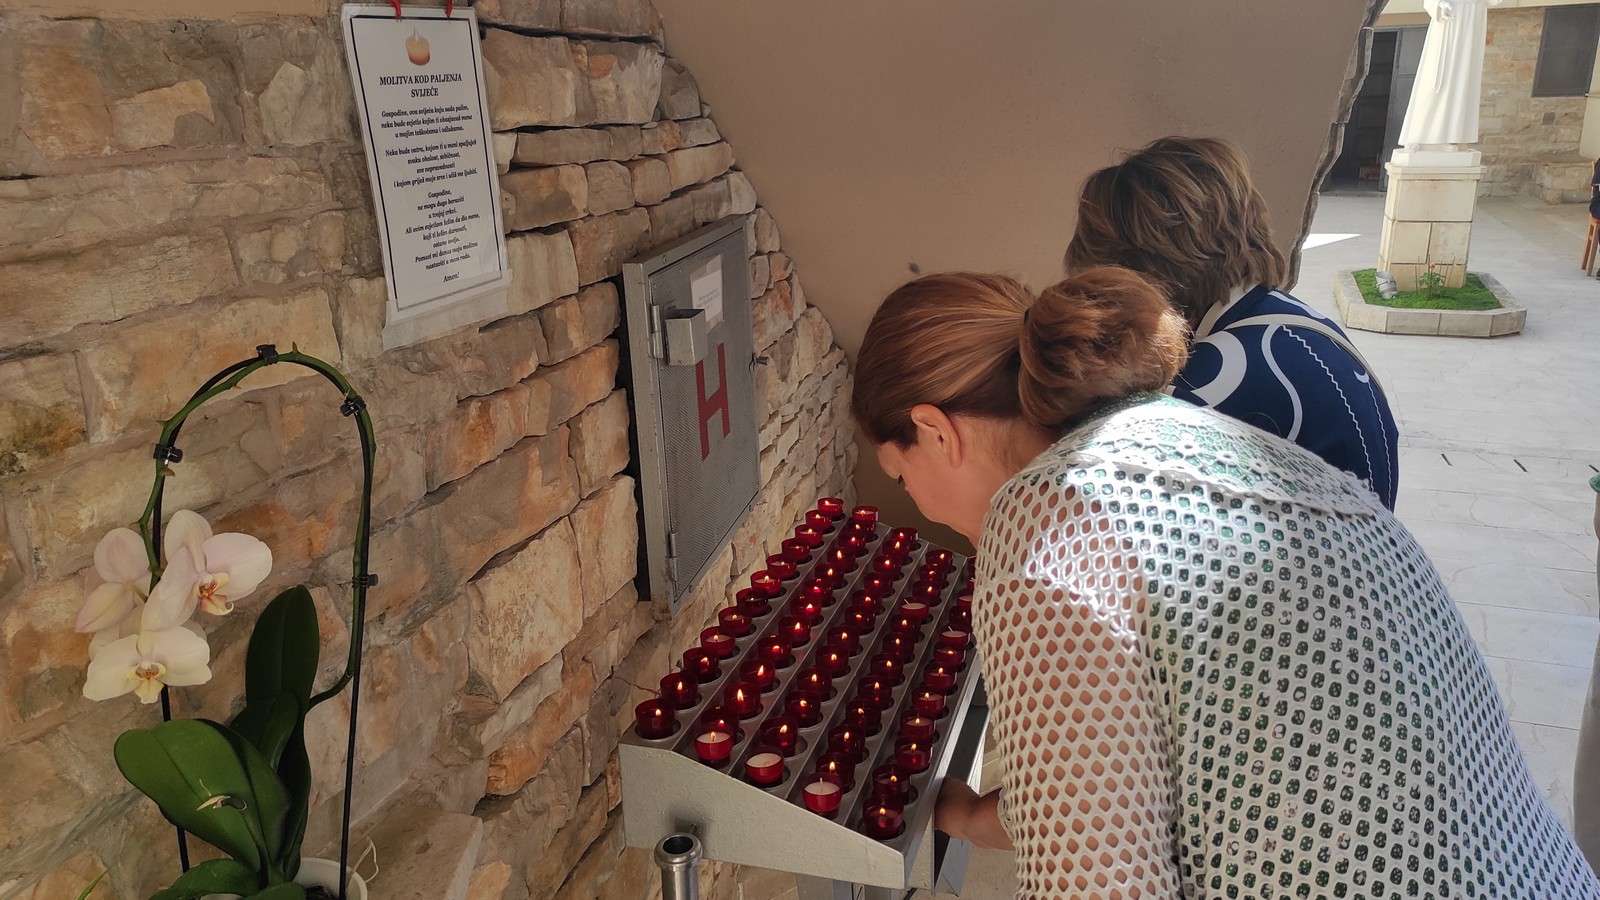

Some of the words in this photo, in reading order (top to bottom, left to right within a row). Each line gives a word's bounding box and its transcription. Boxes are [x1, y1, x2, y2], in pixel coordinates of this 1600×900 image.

[380, 76, 413, 85] MOLITVA
[415, 75, 429, 84] KOD
[431, 73, 462, 82] PALJENJA
[411, 86, 438, 97] SVIJEĆE
[382, 109, 408, 118] Gospodine,
[444, 272, 460, 282] Amen!
[695, 342, 730, 461] H
